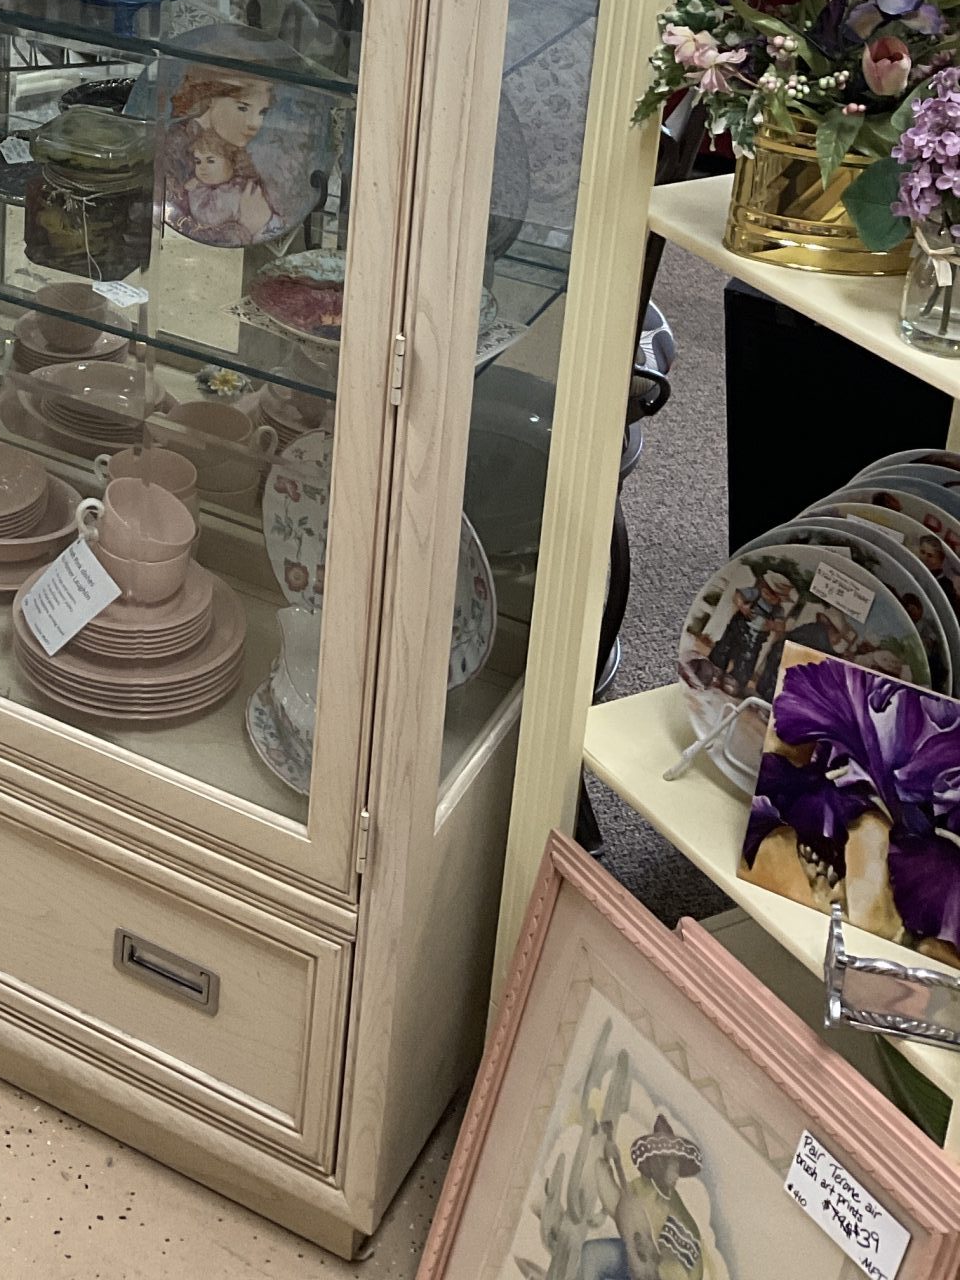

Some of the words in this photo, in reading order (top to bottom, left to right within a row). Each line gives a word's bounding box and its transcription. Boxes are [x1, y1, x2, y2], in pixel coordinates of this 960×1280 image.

[796, 1153, 817, 1181] brush
[820, 1179, 835, 1195] art
[836, 1193, 863, 1222] prints
[804, 1136, 824, 1160] Pair
[864, 1203, 882, 1219] air
